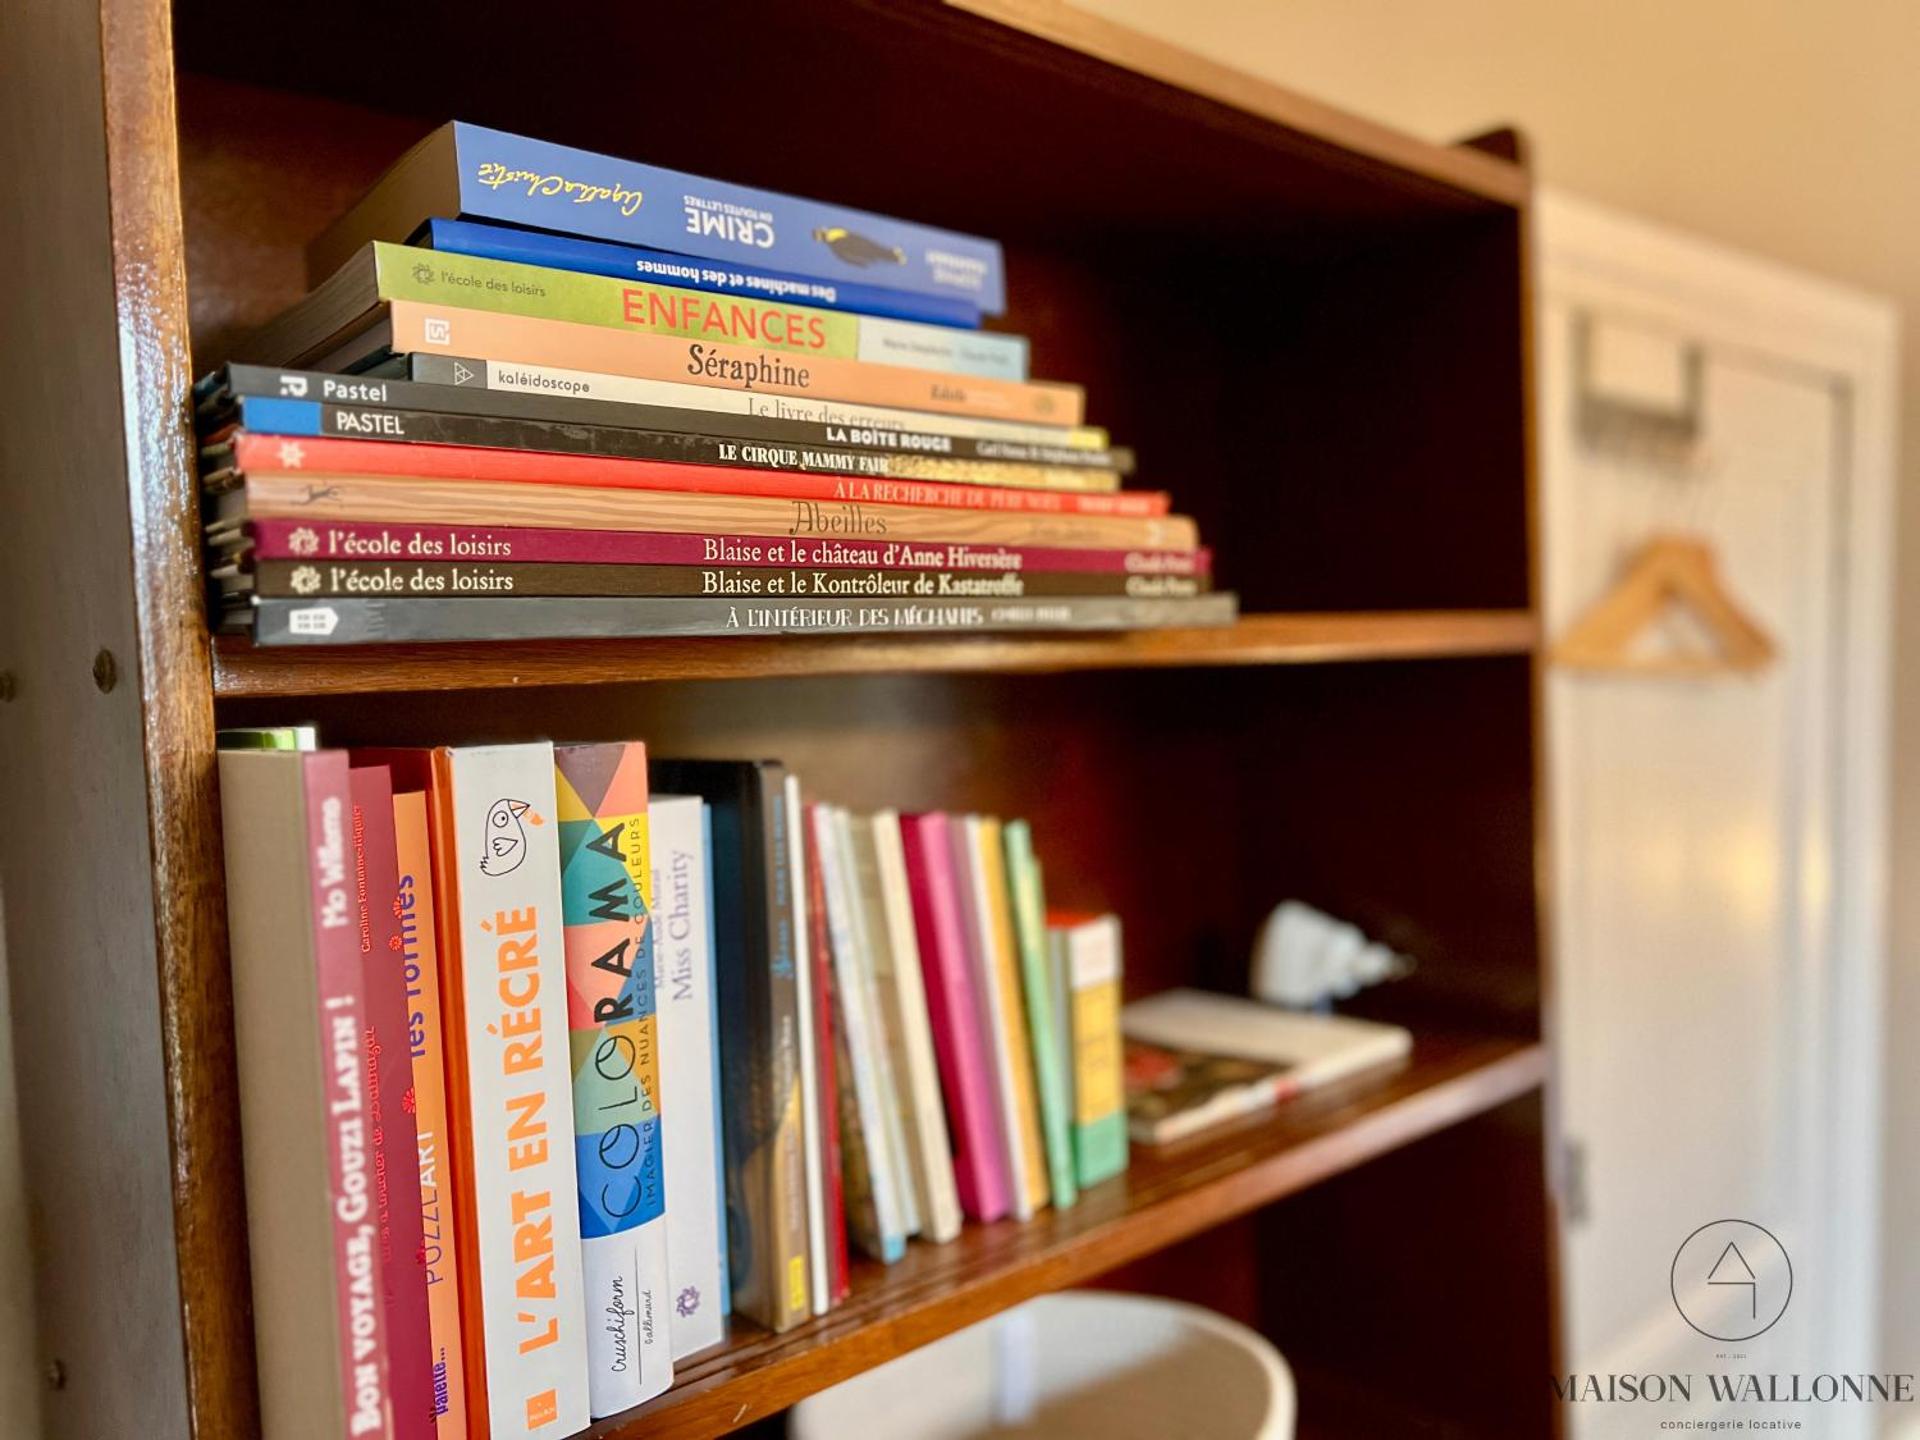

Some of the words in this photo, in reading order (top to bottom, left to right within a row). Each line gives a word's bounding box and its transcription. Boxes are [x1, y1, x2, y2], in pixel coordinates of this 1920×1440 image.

[684, 195, 722, 212] LETTRES
[724, 203, 758, 220] TOUTES
[684, 206, 774, 248] CRIME
[441, 270, 482, 288] l'école
[486, 278, 508, 292] des
[512, 281, 546, 296] loisirs
[636, 260, 699, 283] hommes
[702, 269, 727, 287] des
[730, 273, 744, 287] et
[747, 276, 810, 296] machines
[812, 285, 836, 302] Des
[622, 288, 826, 349] ENFANCES
[498, 369, 590, 395] kaléidoscope
[687, 344, 810, 388] Séraphine
[322, 379, 388, 402] Pastel
[336, 412, 405, 436] PASTEL
[748, 398, 769, 417] Le
[776, 399, 813, 422] livre
[818, 405, 845, 426] des
[826, 426, 848, 442] LA
[850, 428, 897, 447] BOÎTE
[901, 434, 952, 452] ROUGE
[718, 444, 737, 460] LE
[741, 446, 798, 468] CIRQUE
[800, 452, 855, 471] MAMMY
[859, 456, 889, 473] FAIR
[834, 477, 846, 499] À
[850, 482, 870, 500] LA
[873, 484, 962, 505] RECHERCHE
[789, 501, 888, 536] Abeilles
[328, 530, 402, 555] l'école
[408, 532, 443, 555] des
[450, 532, 512, 556] loisirs
[703, 538, 761, 563] Blaise
[767, 545, 785, 563] et
[790, 540, 806, 564] le
[812, 543, 878, 565] château
[883, 544, 944, 567] d'Anne
[330, 566, 404, 592] l'école
[410, 568, 445, 591] des
[452, 568, 514, 591] loisirs
[702, 571, 761, 594] Blaise
[767, 577, 785, 594] et
[790, 572, 807, 594] le
[812, 572, 909, 594] Kontrôleur
[914, 572, 934, 594] de
[726, 606, 740, 628] À
[748, 606, 852, 628] L'INTÉRIEUR
[860, 608, 889, 626] DES
[630, 818, 645, 925] COULEURS
[668, 849, 695, 941] Charity
[357, 905, 372, 953] Caroline
[400, 874, 421, 998] formes
[636, 936, 646, 960] DE
[480, 906, 543, 1076] RÉCRÉ
[671, 947, 694, 1003] Miss
[325, 995, 355, 1009] !
[636, 969, 649, 1066] NUANCES
[409, 1012, 426, 1058] les
[586, 822, 642, 1218] COLORAMA
[331, 1016, 362, 1116] LAPIN
[640, 1074, 652, 1113] DES
[505, 1091, 549, 1172] EN
[337, 1117, 368, 1223] GOUZI
[643, 1117, 656, 1206] IMAGIER
[511, 1190, 560, 1355] L'ART
[346, 1224, 377, 1361] VOYAGE,
[606, 1274, 636, 1373] Cruschiform
[640, 1290, 654, 1345] Gallimard
[351, 1362, 382, 1437] BON
